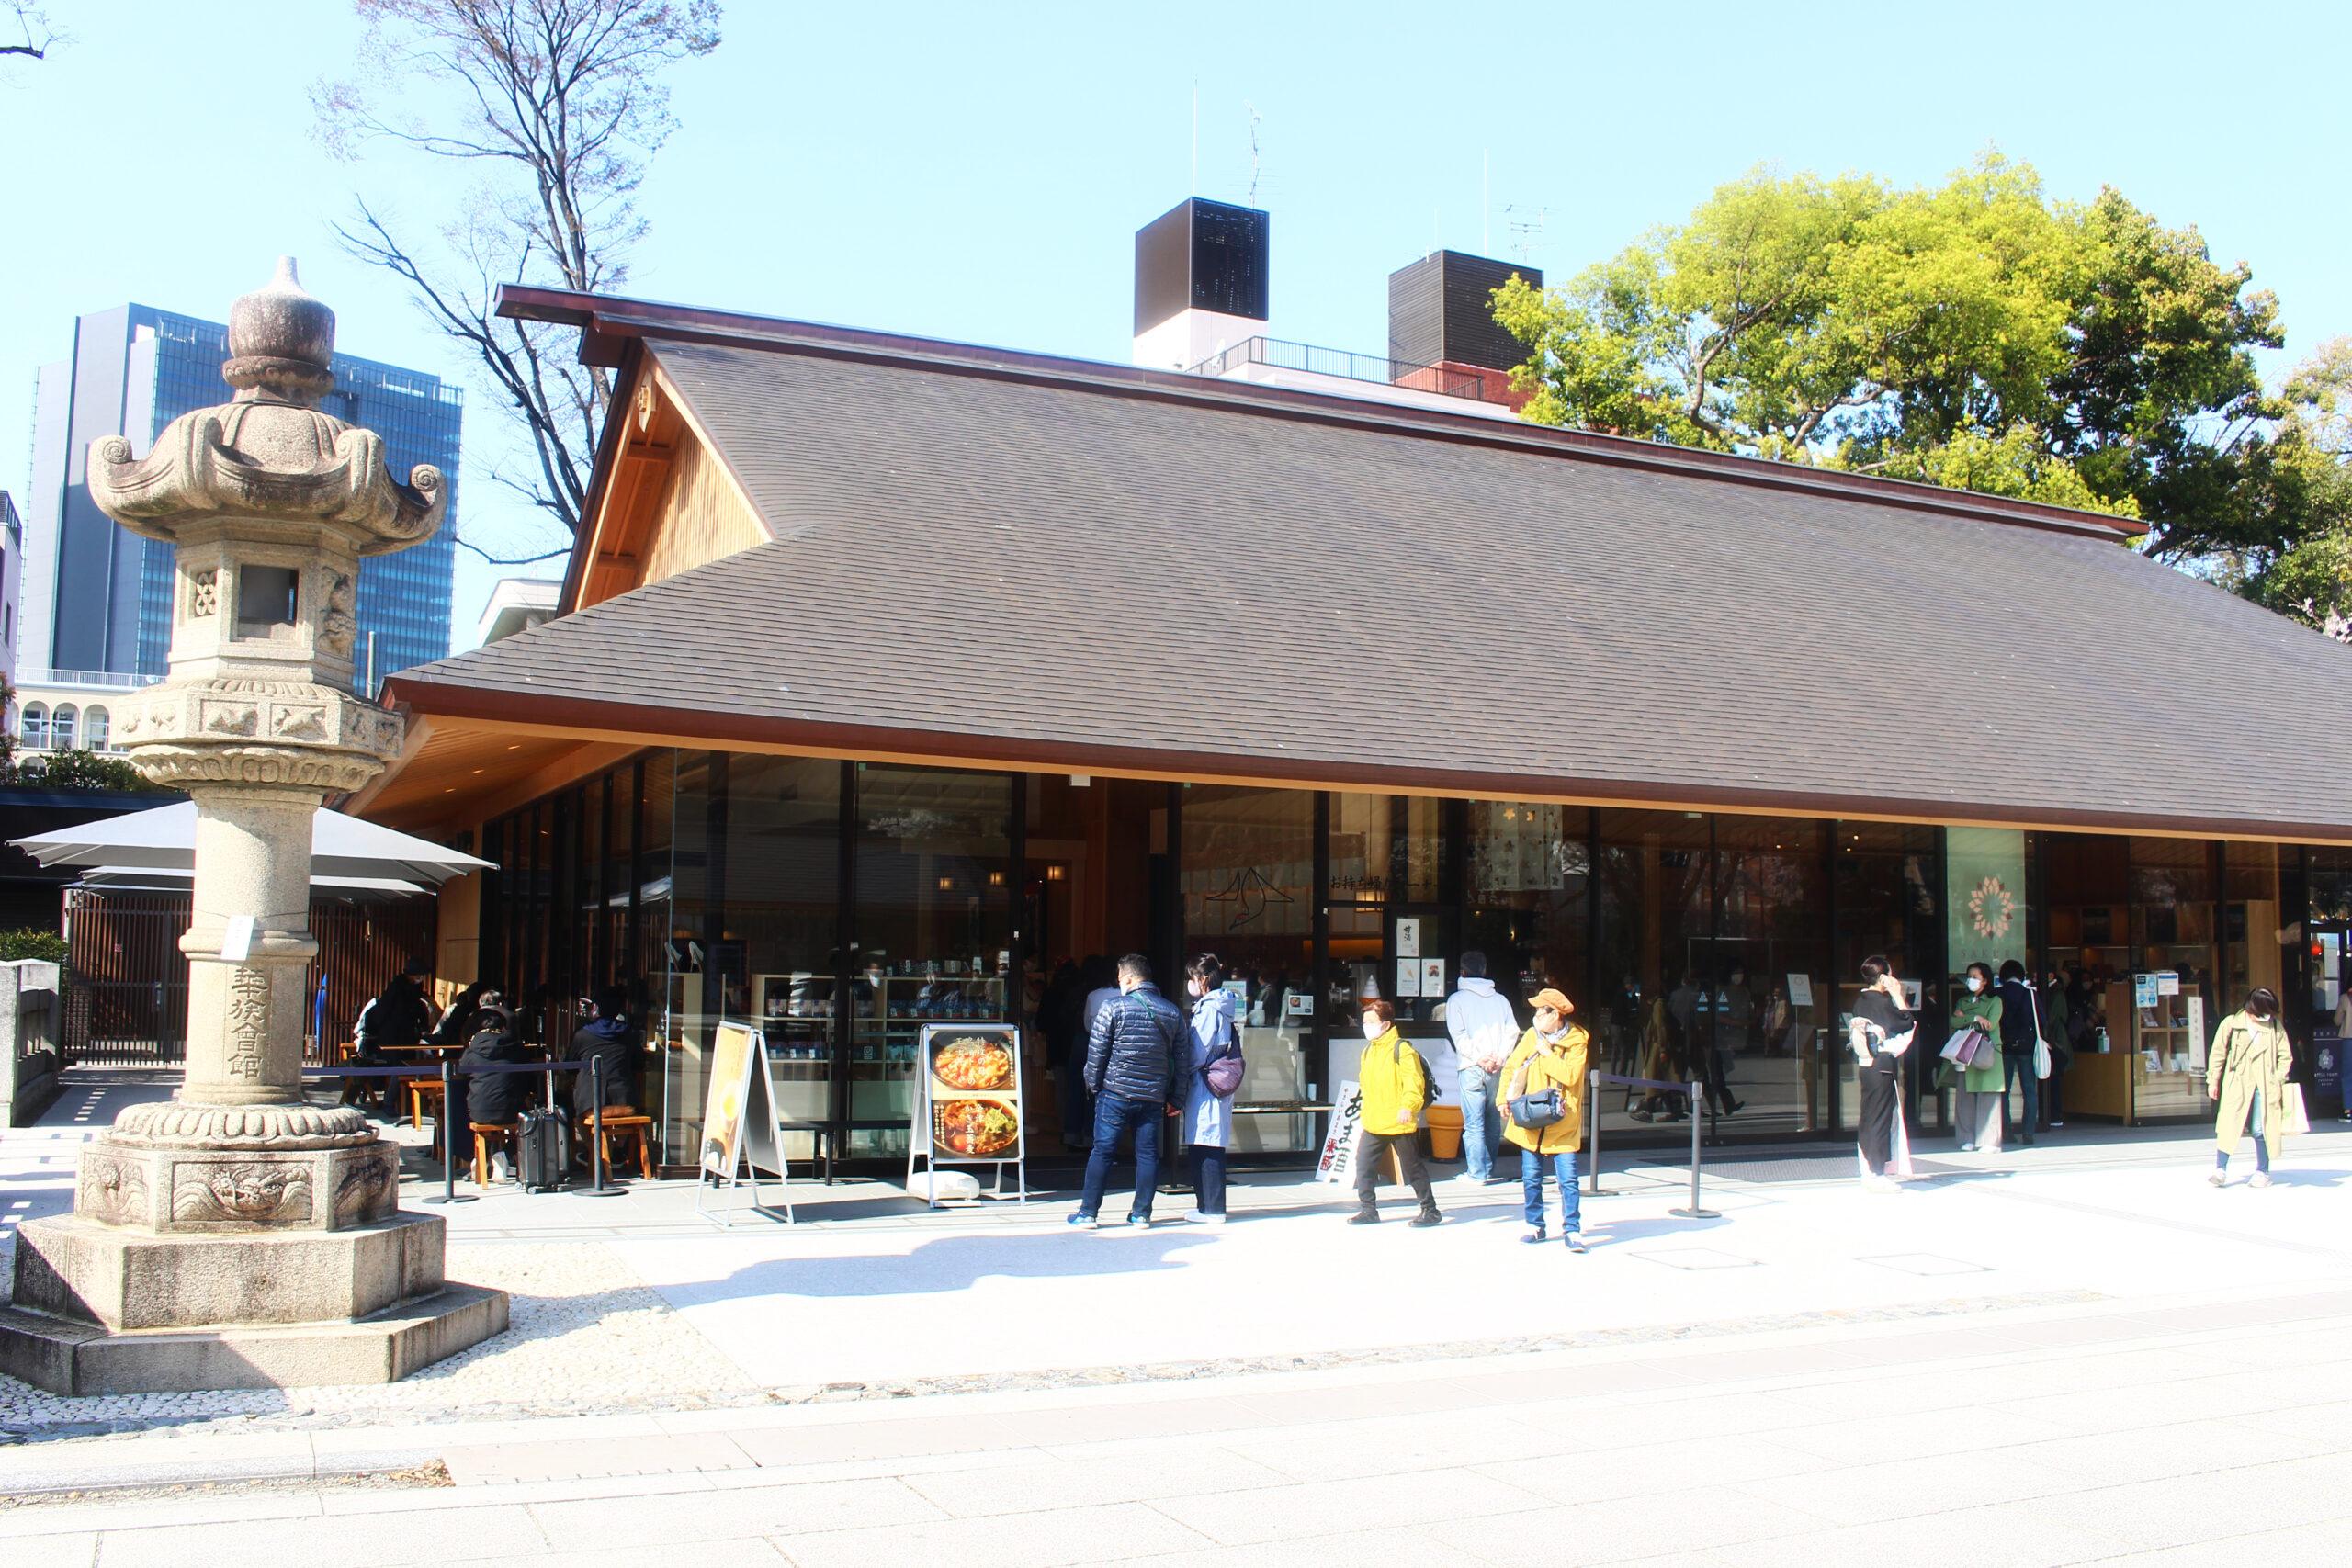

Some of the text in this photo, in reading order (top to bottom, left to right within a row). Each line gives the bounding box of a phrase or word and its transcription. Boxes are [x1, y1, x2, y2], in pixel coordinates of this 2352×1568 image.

[1330, 875, 1437, 890] お持ち帰りーナー
[1962, 948, 2021, 958] SAKURA
[228, 966, 268, 1078] 華族會館
